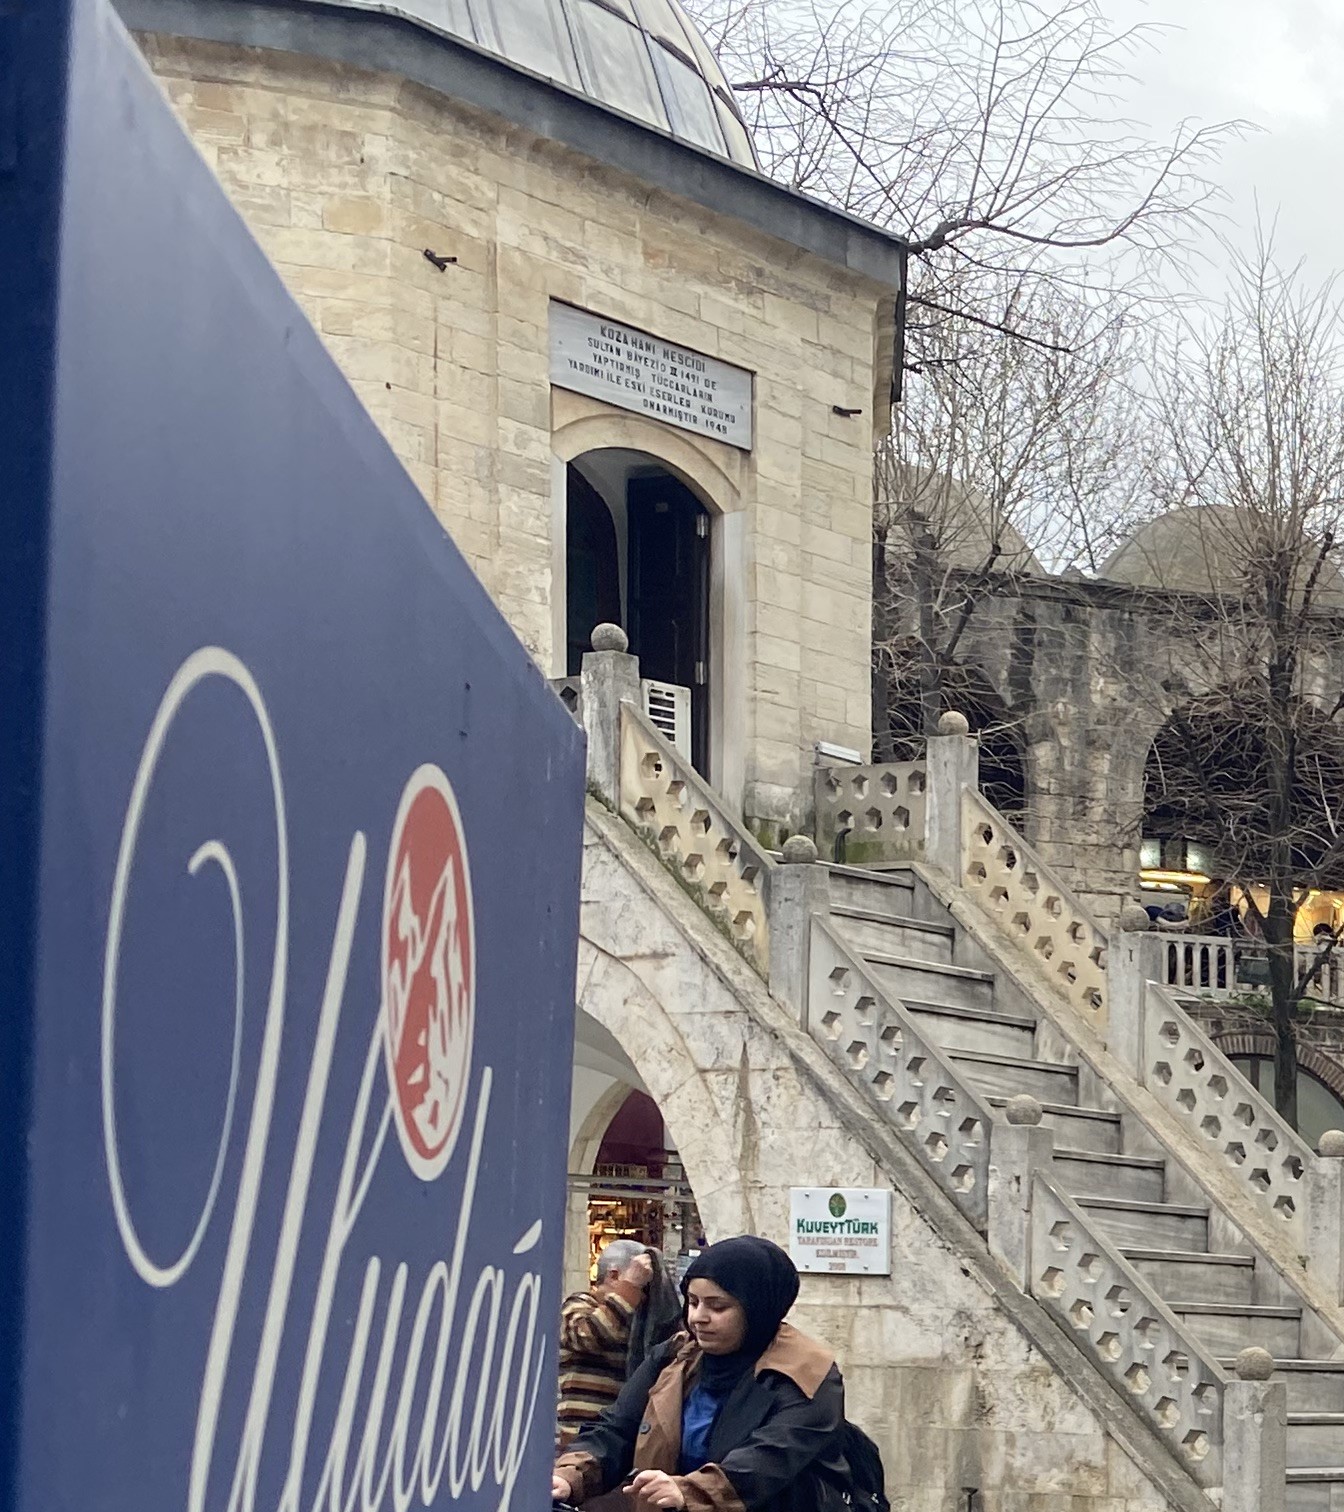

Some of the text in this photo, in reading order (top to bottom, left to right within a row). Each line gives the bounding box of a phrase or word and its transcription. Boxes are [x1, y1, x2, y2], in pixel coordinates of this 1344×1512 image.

[600, 325, 629, 346] KOZA
[631, 337, 656, 355] HANI
[587, 337, 621, 357] SULTAN
[681, 371, 699, 384] 1491
[704, 378, 717, 391] DE
[592, 352, 641, 379] YAPTIRMIŞ
[650, 388, 691, 409] ESERLER
